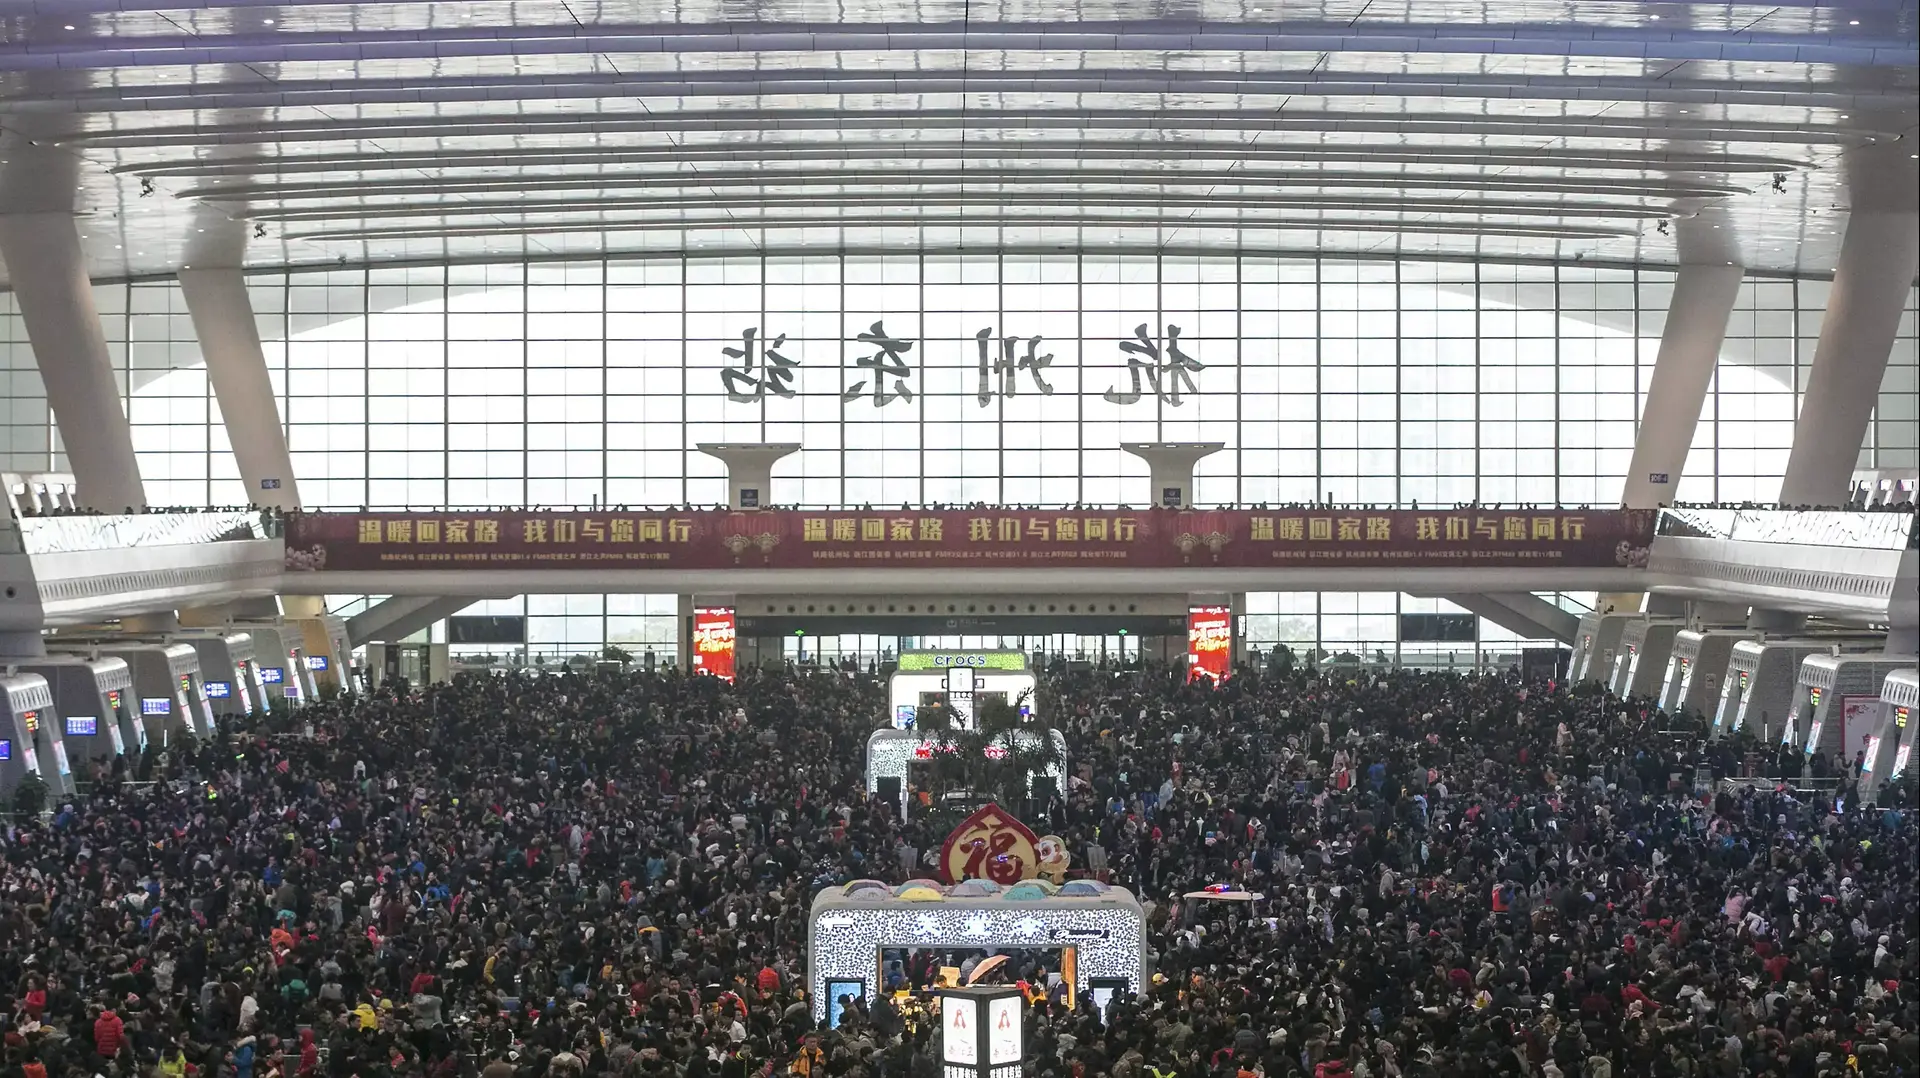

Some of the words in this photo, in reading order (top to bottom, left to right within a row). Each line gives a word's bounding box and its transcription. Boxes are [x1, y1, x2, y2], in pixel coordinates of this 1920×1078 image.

[359, 520, 498, 543] 温暖回家路
[523, 518, 691, 542] 我们与您同行
[804, 518, 943, 542] 温暖回家路
[968, 517, 1137, 541] 我们与您同行
[1251, 516, 1390, 541] 温暖回家路
[1416, 516, 1585, 540] 我们与您同行
[935, 655, 985, 666] crocs
[960, 824, 1023, 885] 福
